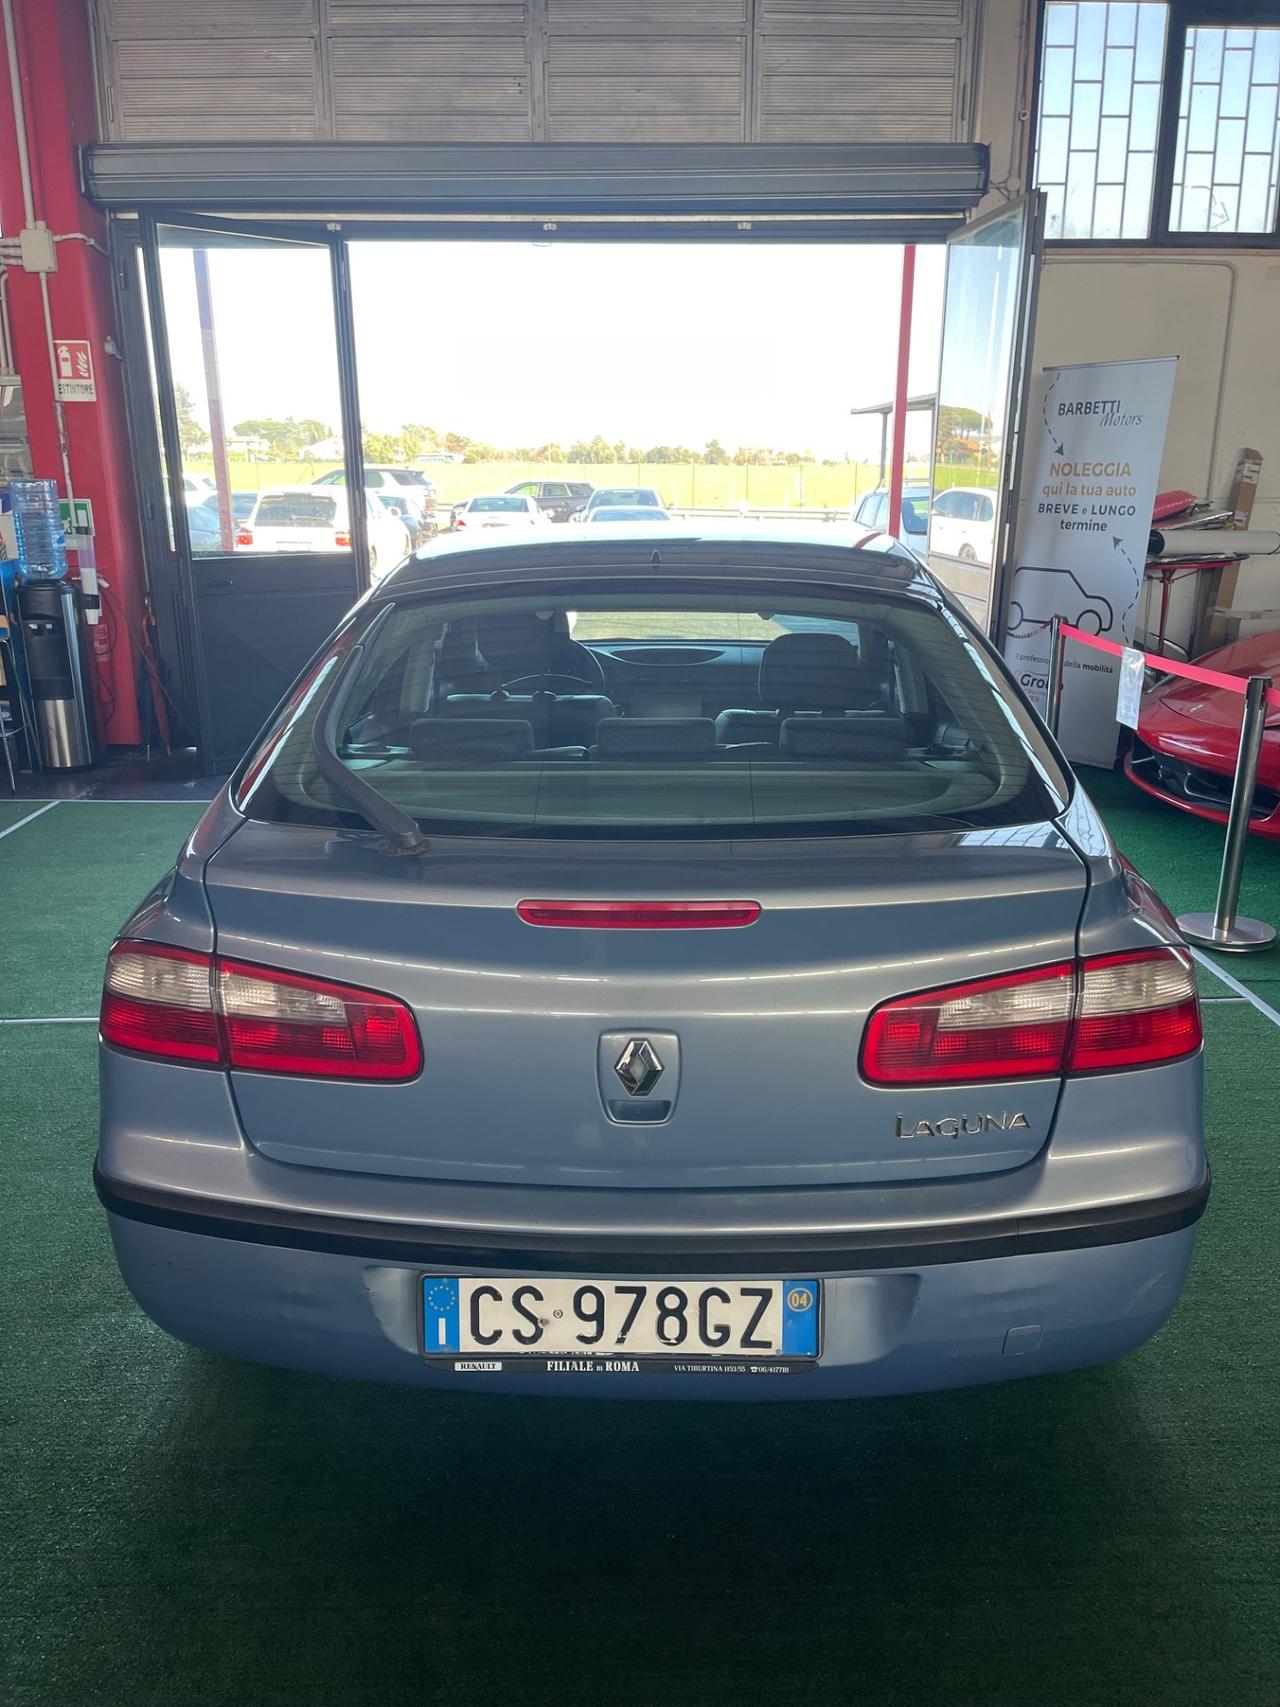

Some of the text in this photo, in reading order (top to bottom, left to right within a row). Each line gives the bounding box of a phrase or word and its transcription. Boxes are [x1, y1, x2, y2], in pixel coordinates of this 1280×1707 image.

[1058, 400, 1121, 416] BARBETTI
[1099, 411, 1144, 427] Motors
[1049, 462, 1132, 477] NOLEGGIA
[1042, 482, 1137, 497] qui la tua auto
[1038, 503, 1136, 517] BREVE e LUNGO
[1060, 519, 1108, 532] termine
[1019, 654, 1049, 665] professio
[1064, 661, 1081, 669] della
[1082, 663, 1114, 674] mobilità
[896, 1112, 1031, 1139] LAGUNA
[790, 1292, 809, 1308] 04
[470, 1285, 773, 1349] CS 978GZ
[438, 1317, 447, 1346] I
[460, 1362, 496, 1371] RENAULT
[546, 1360, 594, 1372] FILIALE
[605, 1360, 640, 1373] ROMA
[674, 1364, 686, 1373] VIA
[687, 1365, 723, 1373] TIBURTINA
